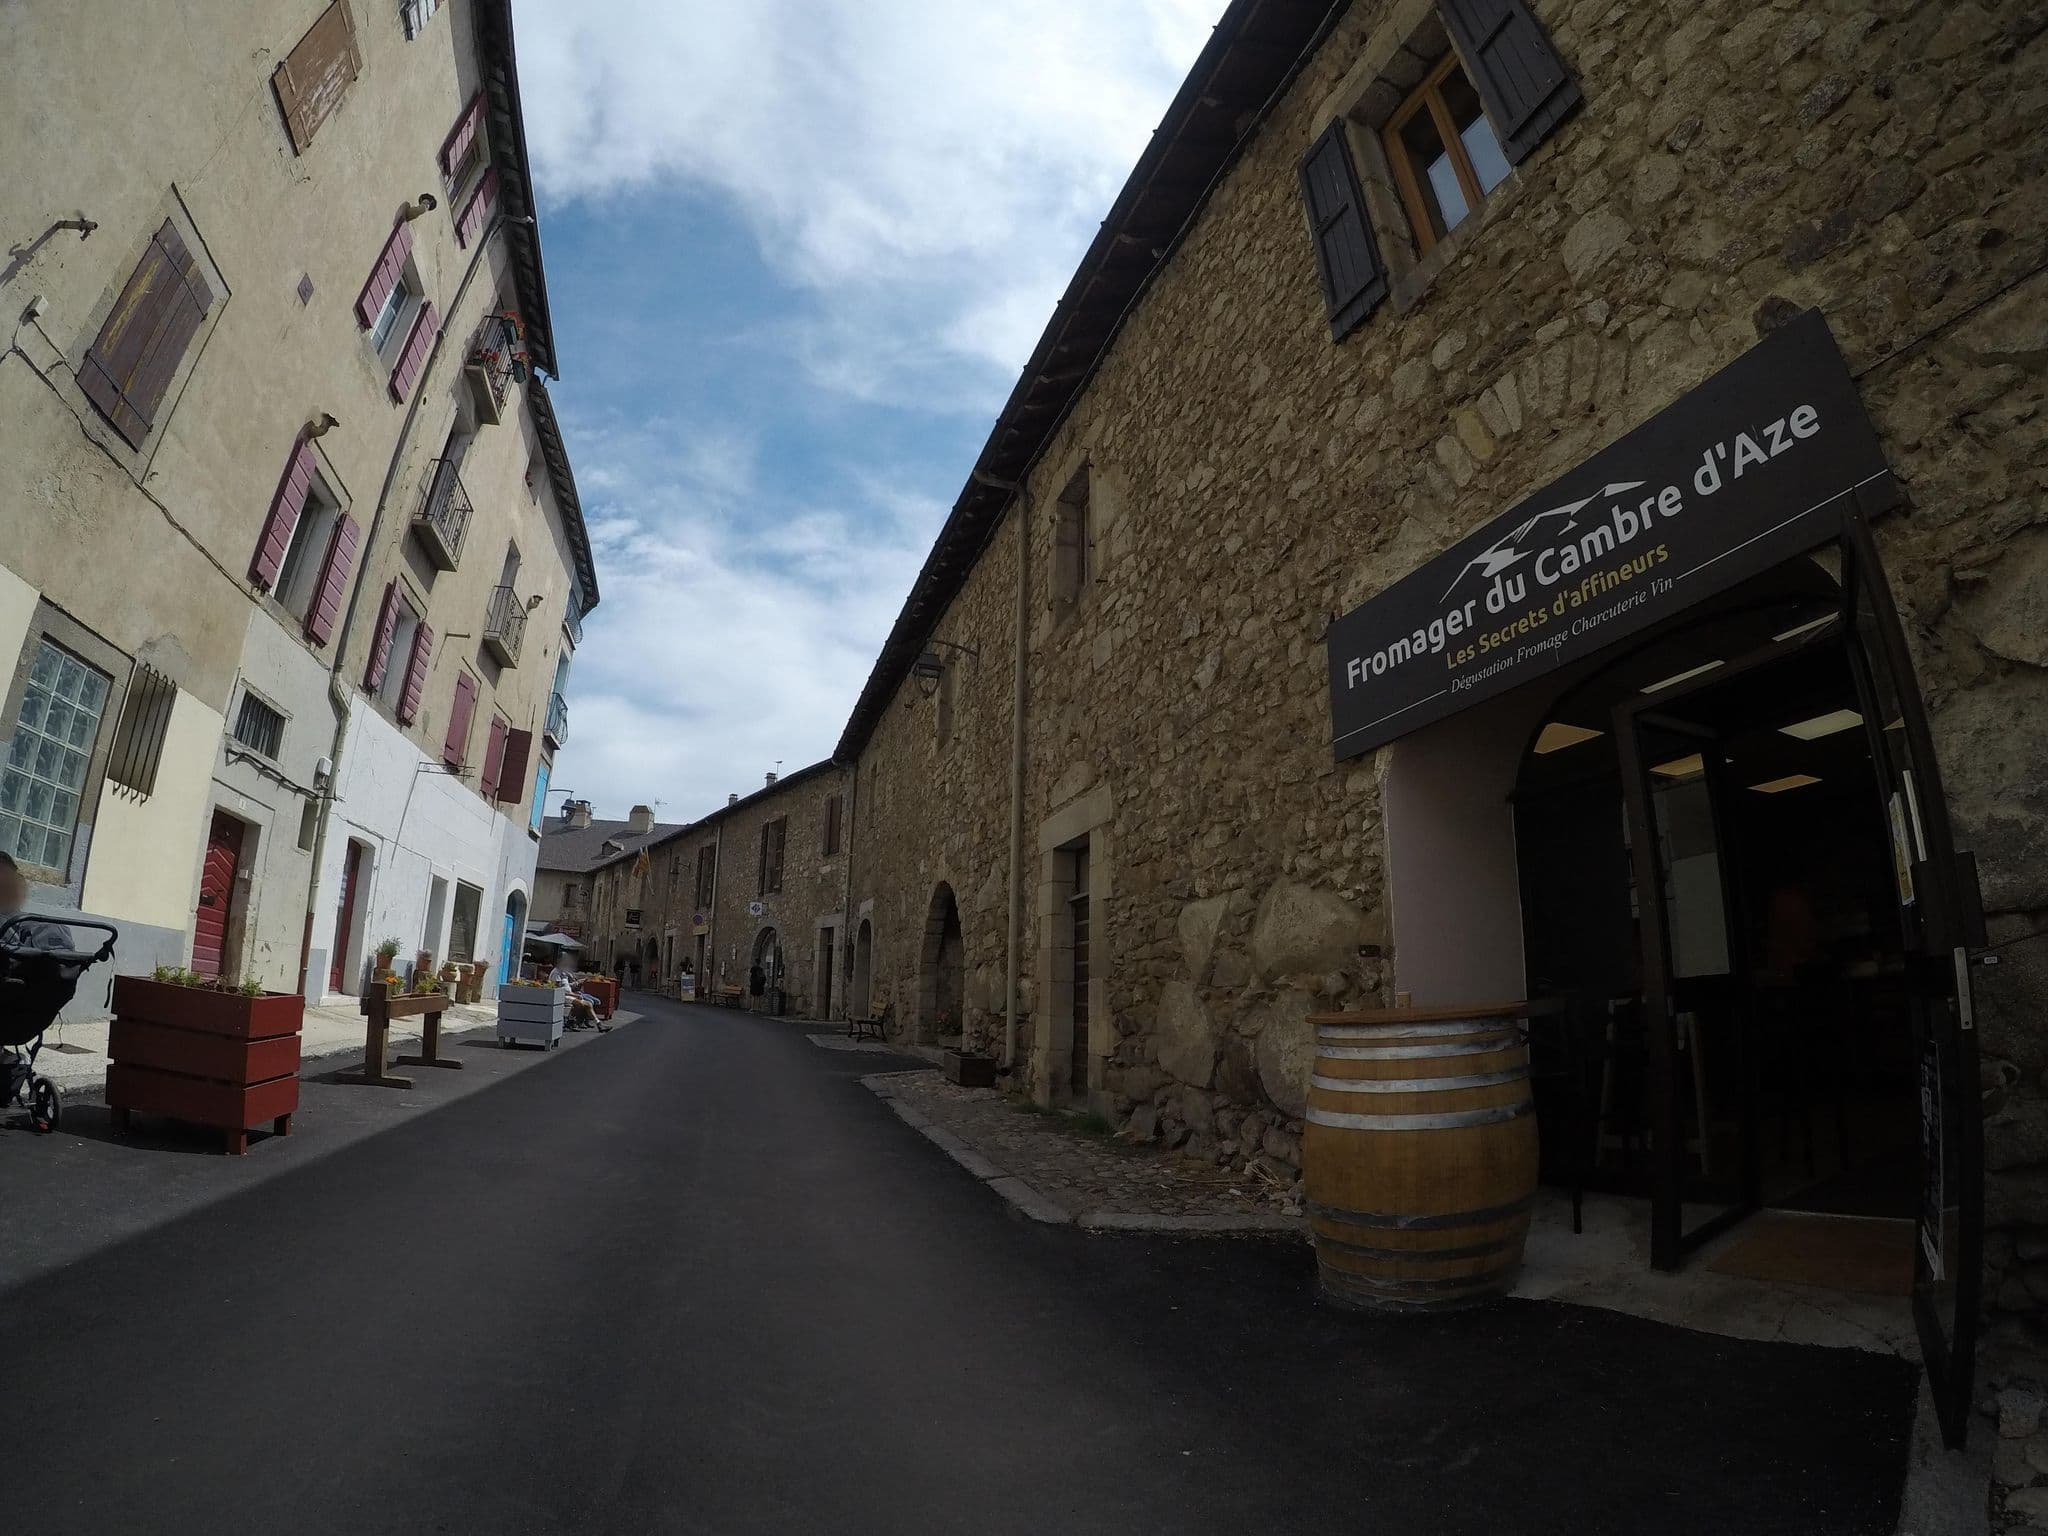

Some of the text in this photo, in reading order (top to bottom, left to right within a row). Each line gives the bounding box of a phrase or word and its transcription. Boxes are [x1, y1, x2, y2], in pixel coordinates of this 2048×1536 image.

[1346, 403, 1821, 689] Fromager du Cambre d'Aze
[1446, 543, 1669, 670] Les Secrets d'affineurs
[1451, 577, 1674, 693] Dégustation Fromage Charcuterie Vin
